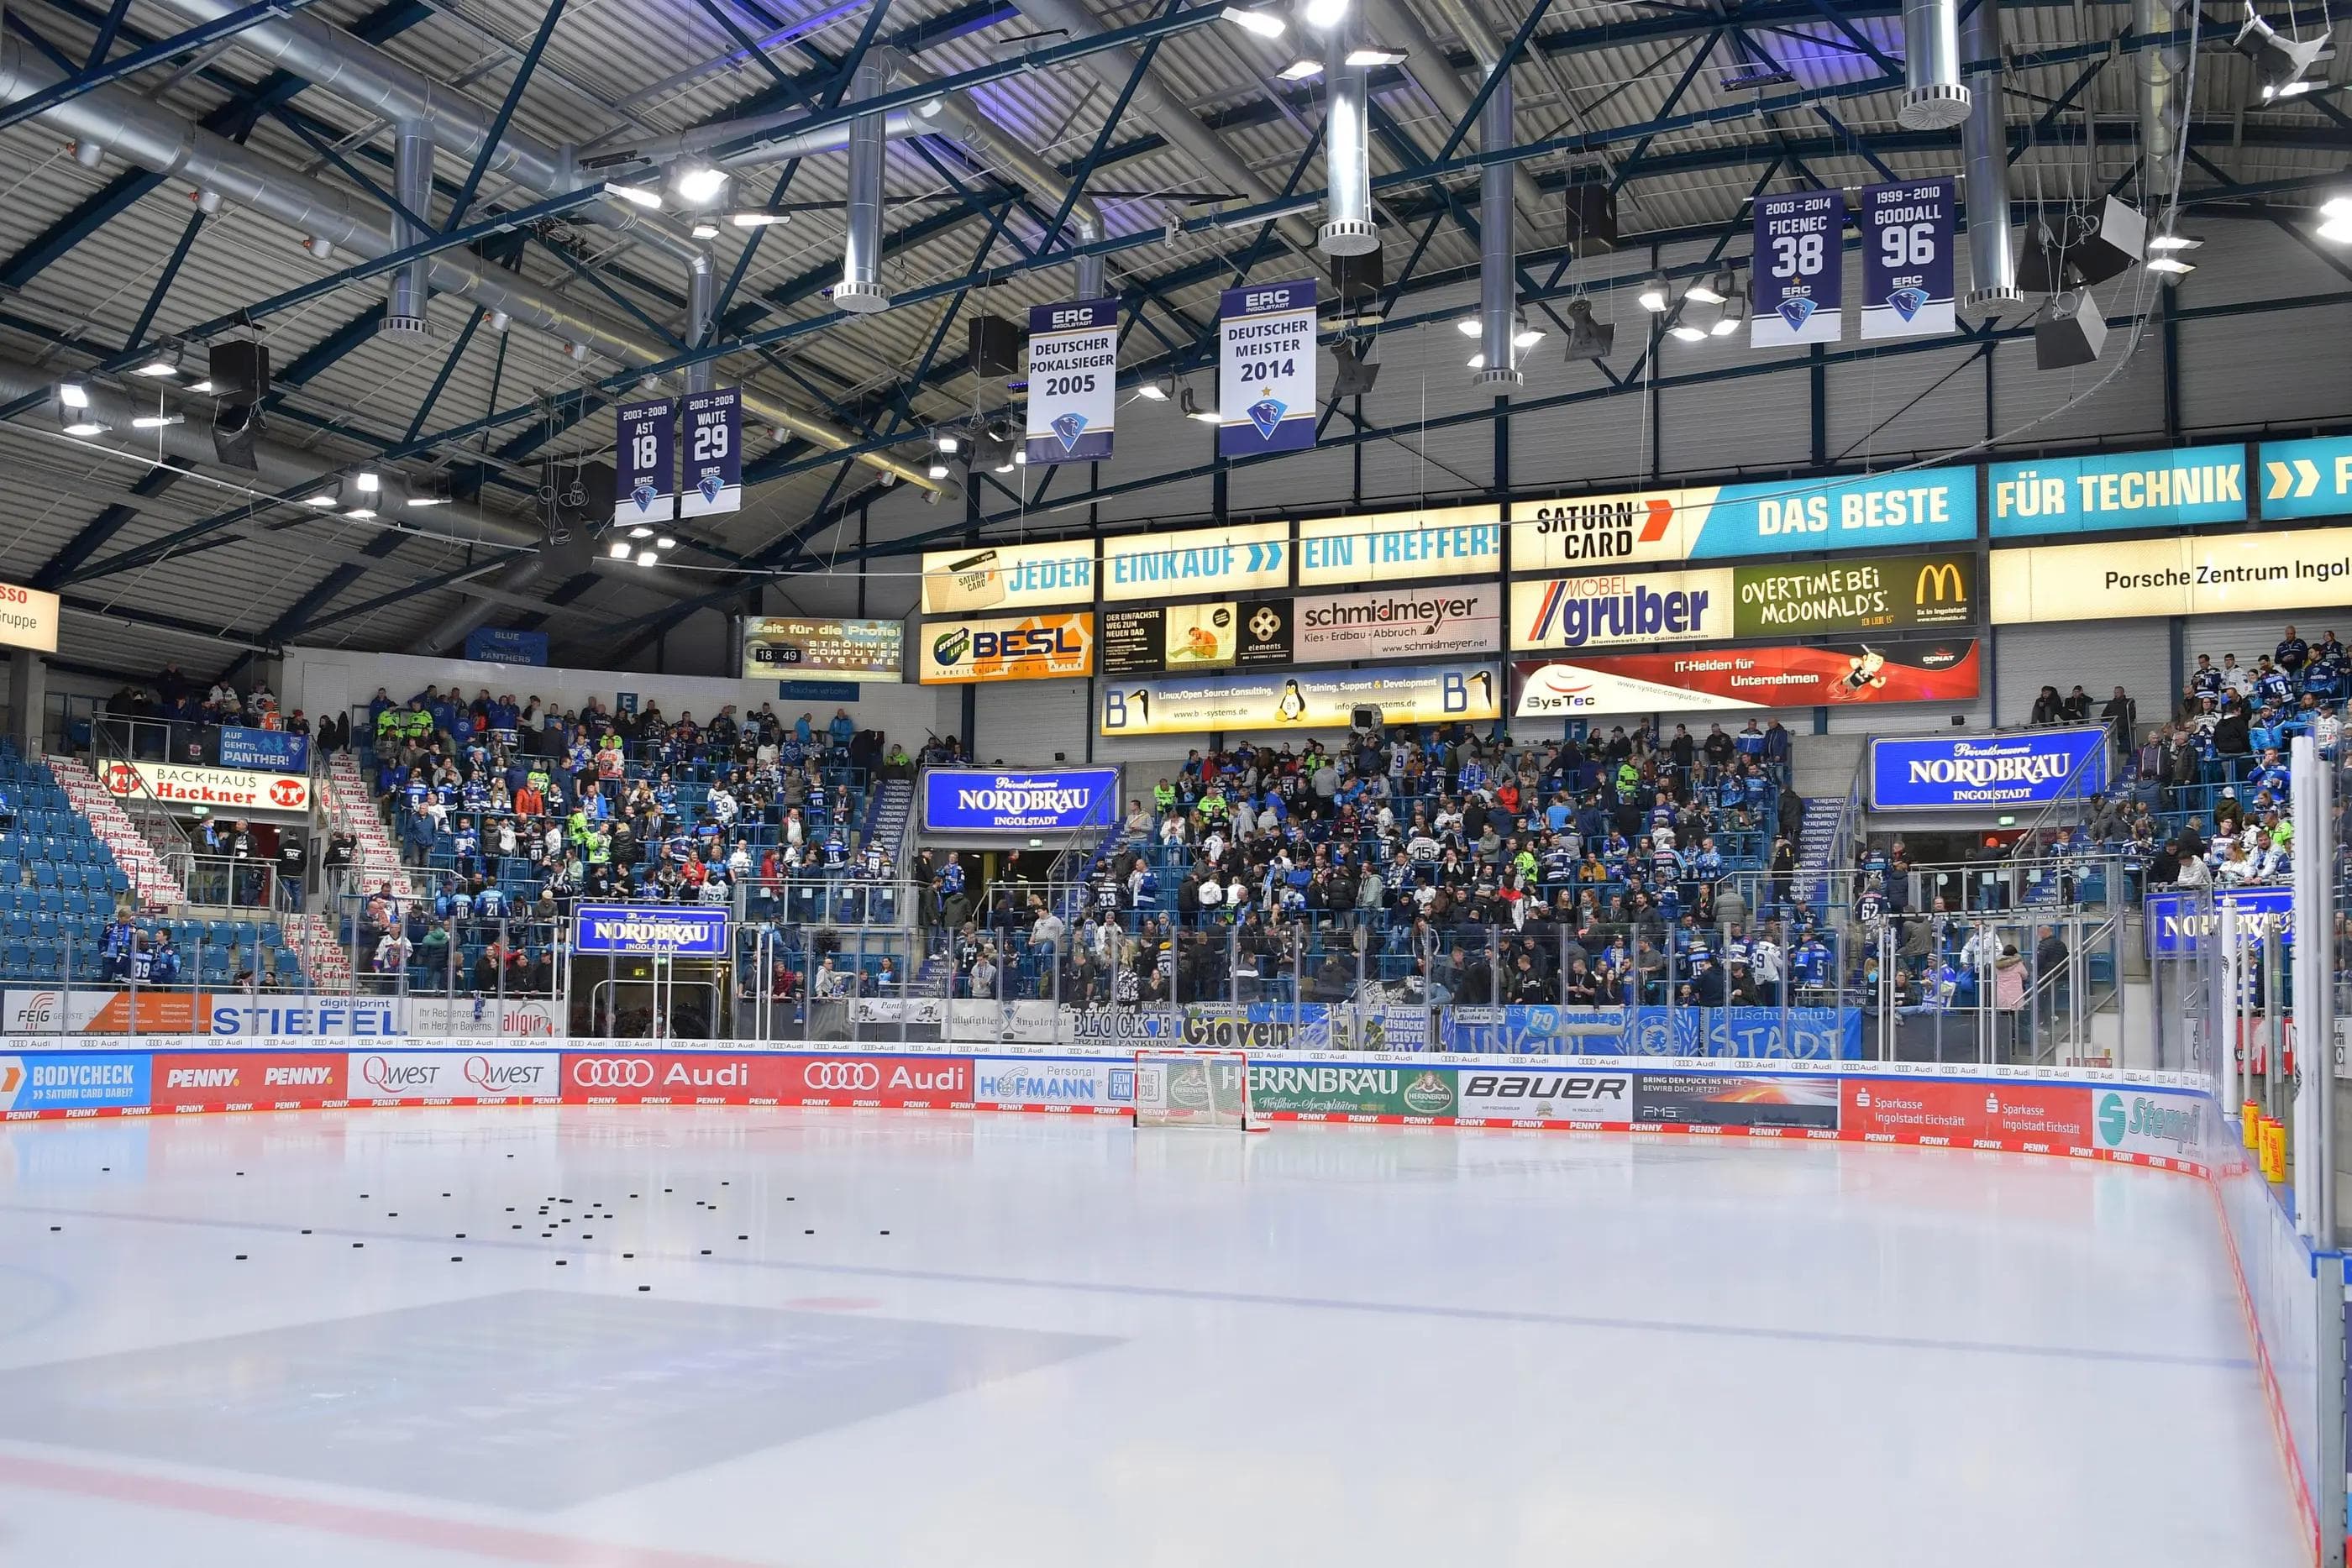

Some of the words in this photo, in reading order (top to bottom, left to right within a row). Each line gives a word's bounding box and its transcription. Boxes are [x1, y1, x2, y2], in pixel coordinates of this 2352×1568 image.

[1874, 204, 1941, 225] GOODALL
[1769, 216, 1827, 235] FICENEC
[1882, 223, 1935, 268] 96
[1772, 233, 1823, 277] 38
[1892, 275, 1923, 285] ERC
[1246, 290, 1290, 307] ERC
[1782, 286, 1811, 295] ERC
[1052, 307, 1093, 323] ERC
[1246, 303, 1289, 312] INGOLSTADT
[1228, 320, 1309, 341] DEUTSCHER
[1035, 338, 1109, 356] DEUTSCHER
[1236, 339, 1300, 358] MEISTER
[1030, 354, 1114, 374] POKALSIEGER
[1241, 359, 1294, 382] 2014
[1046, 375, 1095, 396] 2005
[697, 410, 726, 426] WAITE
[635, 422, 654, 436] AST
[694, 424, 728, 462] 29
[633, 436, 657, 470] 18
[1997, 470, 2066, 518] FÜR
[2077, 464, 2242, 512] TECHNIK
[1536, 501, 1633, 534] SATURN
[1758, 495, 1829, 537] DAS
[1840, 485, 1949, 532] BESTE
[1305, 536, 1352, 569] EIN
[1366, 523, 1499, 569] TREFFER!
[1564, 529, 1633, 559] CARD
[1115, 545, 1235, 584] EINKAUF
[1009, 557, 1090, 592] JEDER
[2105, 569, 2191, 590] Porsche
[2196, 564, 2288, 585] Zentrum
[1565, 576, 1631, 597] MÖBEL
[1106, 613, 1120, 621] DER
[1121, 611, 1160, 620] EINFACHSTE
[1305, 597, 1478, 633] schmidmeyer
[1563, 585, 1709, 645] gruber
[495, 632, 520, 641] BLUE
[752, 623, 785, 633] Zeit
[789, 625, 814, 635] für
[819, 625, 843, 635] die
[1105, 629, 1130, 637] NEUEN
[1304, 632, 1325, 642] Kies
[1331, 629, 1367, 642] Erdbau
[1373, 627, 1417, 639] Abbruch
[937, 631, 965, 653] SYSTEM
[949, 642, 966, 656] LIFT
[973, 627, 1082, 658] BESL
[1248, 643, 1282, 652] elements
[1381, 638, 1488, 653] www.schmidmeyer.net
[480, 652, 531, 663] PANTHERS
[809, 648, 900, 657] COMPUTER
[813, 657, 894, 665] SYSTEME
[1674, 659, 1732, 672] IT-Helden
[1735, 659, 1755, 669] für
[1158, 690, 1203, 701] Linux/Open
[1204, 689, 1229, 698] Source
[1340, 681, 1372, 692] Support
[1383, 678, 1437, 690] Development
[1730, 674, 1819, 687] Unternehmen
[622, 695, 632, 709] E
[1527, 695, 1595, 710] SysTec
[224, 732, 243, 740] AUF
[1571, 721, 1583, 740] F
[223, 751, 290, 766] PANTHER!
[157, 768, 256, 788] BACKHAUS
[1908, 753, 2070, 787] NORDBRÄU
[156, 782, 256, 804] Hackner
[958, 788, 1089, 815] NORDBRÄU
[1953, 788, 2032, 800] INGOLSTADT
[994, 816, 1058, 826] INGOLSTADT
[320, 998, 390, 1009] digitalprint
[419, 1008, 429, 1017] Ihr
[18, 1010, 50, 1022] FEIG
[213, 1008, 407, 1036] STIEFEL
[461, 1021, 494, 1033] Bayerns.
[1710, 1023, 1845, 1060] STADT
[33, 1065, 134, 1086] BODYCHECK
[167, 1067, 240, 1088] PENNY.
[265, 1067, 333, 1086] PENNY.
[664, 1062, 748, 1086] Audi
[888, 1067, 963, 1090] Audi
[1047, 1067, 1095, 1076] Personal
[1113, 1072, 1131, 1083] KEIN
[1223, 1065, 1398, 1095] HERRNBRÄU
[45, 1089, 78, 1099] SATURN
[81, 1089, 102, 1099] CARD
[105, 1088, 134, 1099] DABEI?
[981, 1076, 1095, 1099] HOFMANN
[1113, 1084, 1131, 1097] FAN
[1874, 1098, 1923, 1111] Sparkasse
[2003, 1103, 2045, 1117] Sparkasse
[1874, 1112, 1924, 1126] Ingolstadt
[1925, 1114, 1966, 1127] Eichstätt
[2003, 1119, 2045, 1133] Ingolstadt
[2046, 1121, 2081, 1135] Eichstätt
